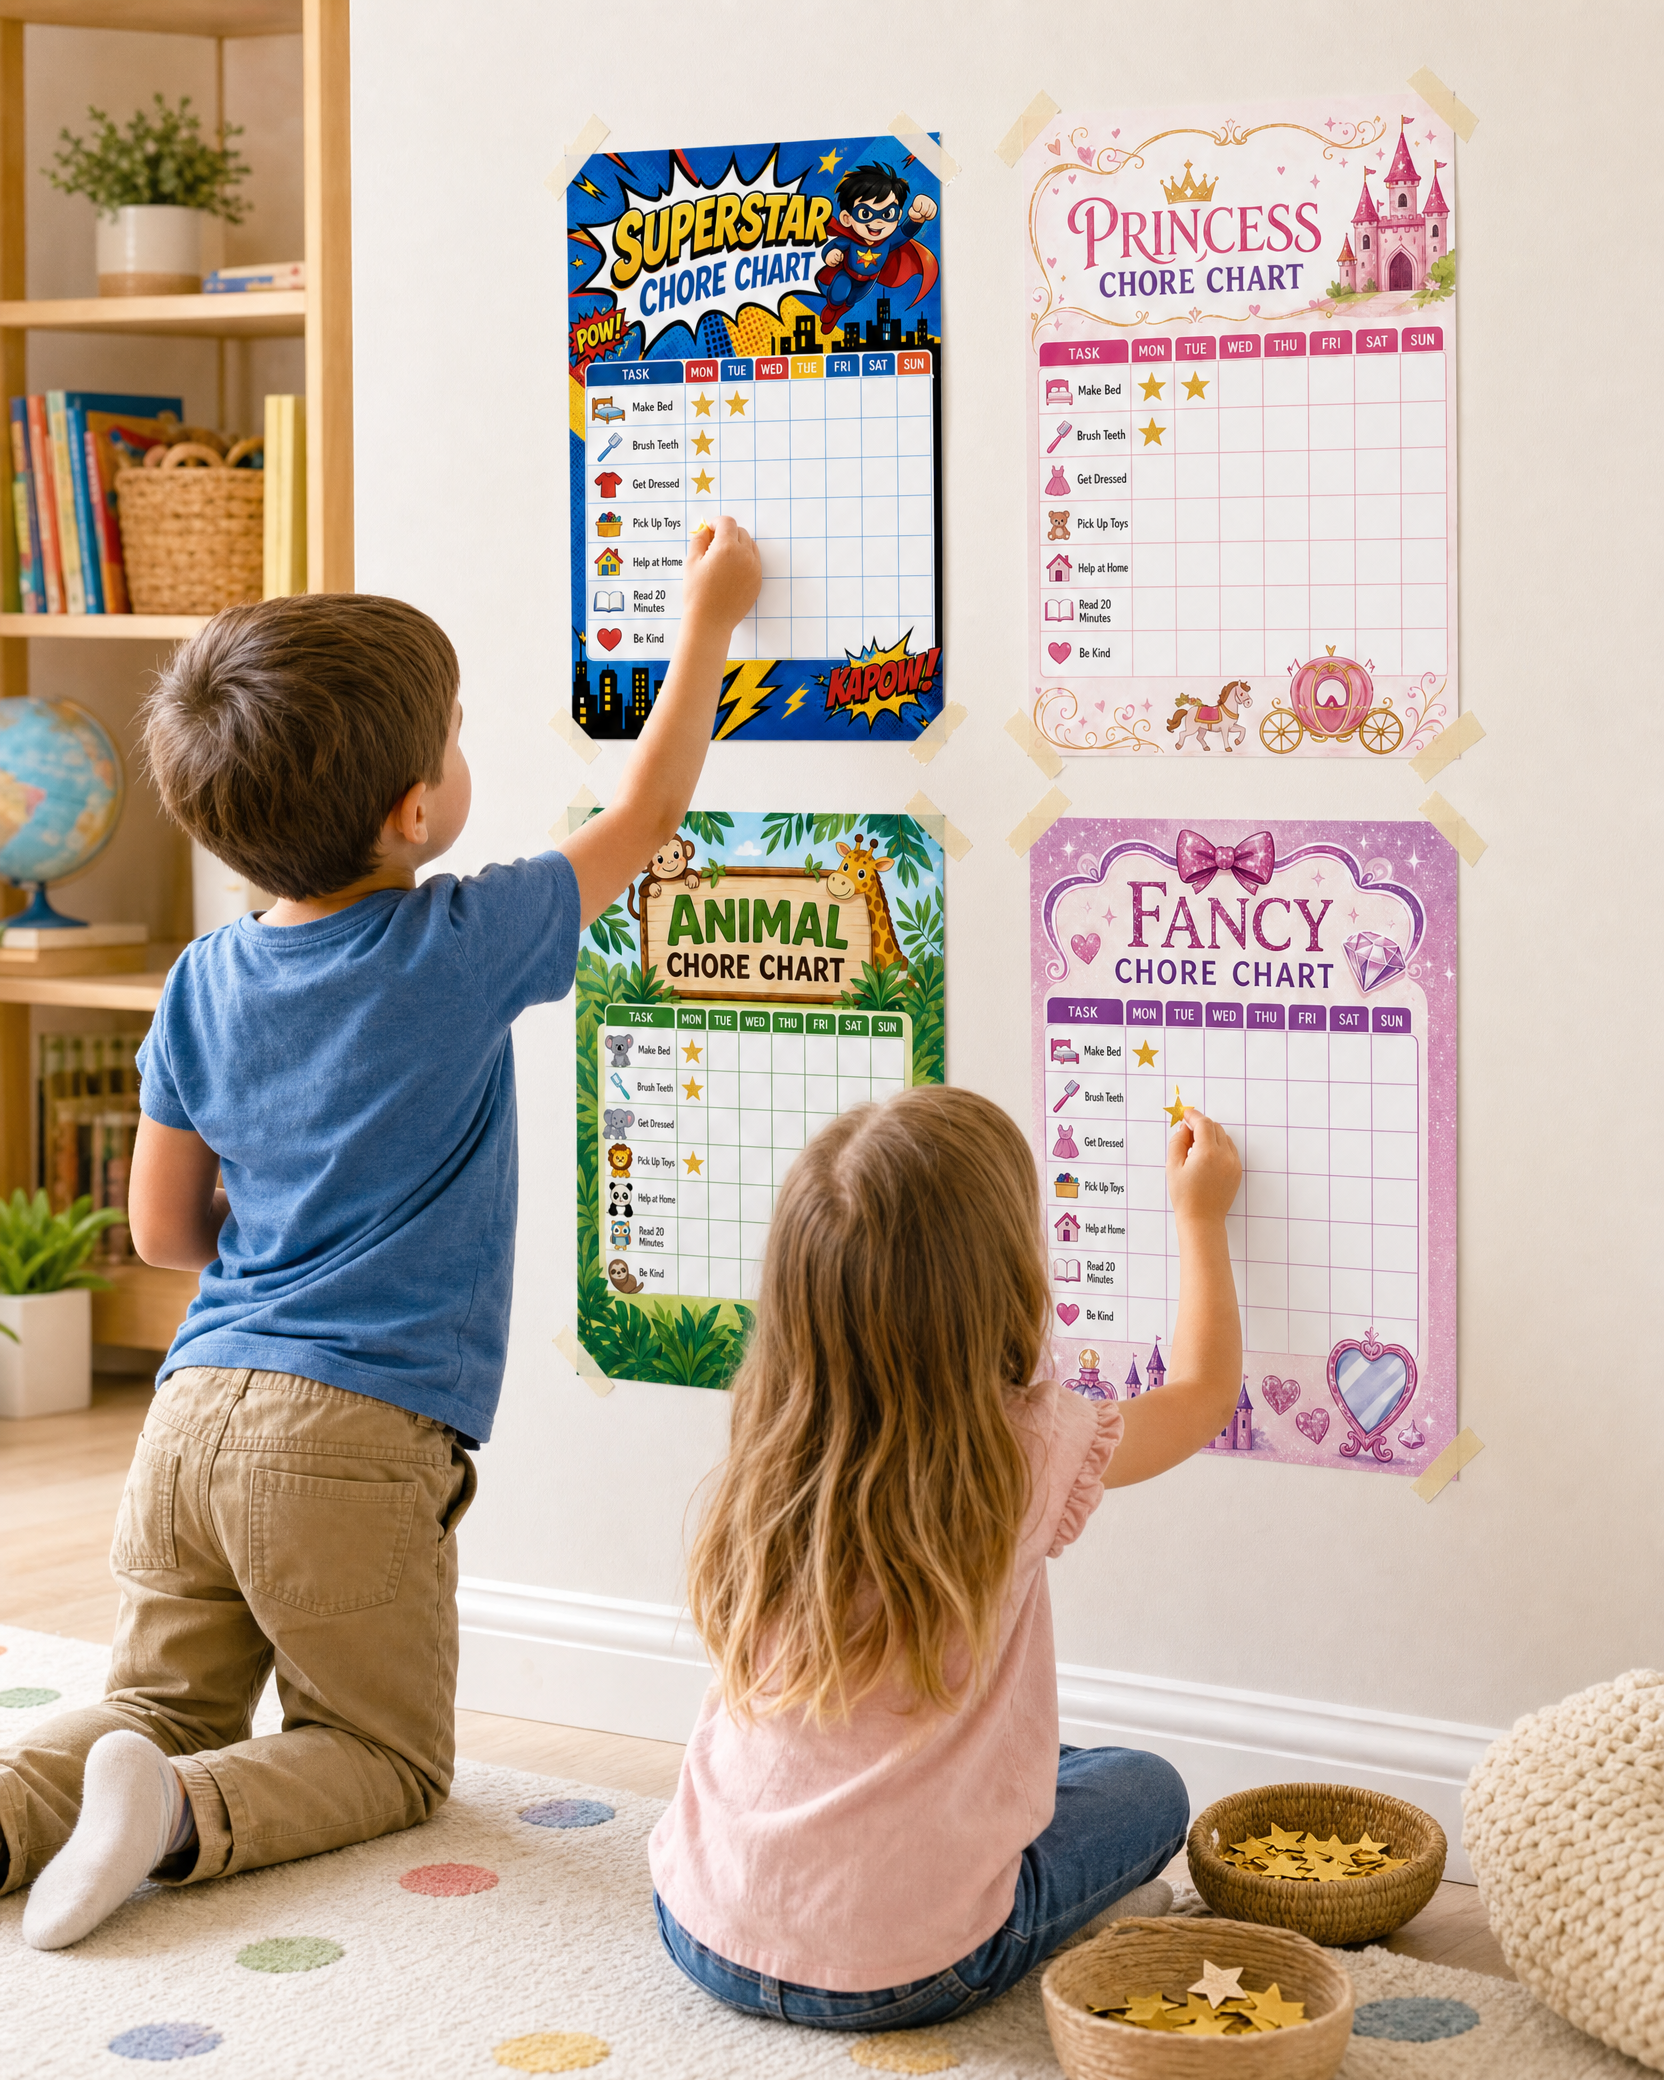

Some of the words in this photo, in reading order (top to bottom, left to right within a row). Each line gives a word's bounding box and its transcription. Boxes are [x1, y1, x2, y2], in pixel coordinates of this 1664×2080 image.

[1067, 196, 1322, 271] PRINCESS
[611, 192, 832, 289] SUPERSTAR
[639, 260, 726, 317] CHORE
[734, 251, 816, 296] CHART
[1099, 268, 1195, 298] CHORE
[1206, 263, 1304, 293] CHART
[574, 312, 623, 352] POW!
[1068, 347, 1100, 360] TASK
[1139, 345, 1165, 357] MON
[1184, 343, 1207, 355] TUE
[1227, 340, 1253, 353] WED
[1273, 339, 1297, 351] THU
[1322, 337, 1341, 349] FRI
[1366, 335, 1388, 348] SAT
[1410, 334, 1435, 346] SUN
[622, 369, 650, 380] TASK
[690, 367, 713, 377] MON
[728, 365, 746, 376] TUE
[761, 363, 783, 375] WED
[797, 362, 817, 374] TUE
[834, 360, 851, 372] FRI
[869, 359, 888, 370] SAT
[903, 358, 924, 370] SUN
[1078, 385, 1102, 396] Make
[1104, 384, 1121, 395] Bed
[632, 402, 654, 412] Make
[657, 400, 673, 411] Bed
[1077, 430, 1101, 441] Brush
[1103, 429, 1126, 440] Teeth
[632, 440, 655, 450] Brush
[657, 439, 679, 449] Teeth
[632, 479, 646, 489] Get
[648, 478, 679, 488] Dressed
[1077, 474, 1092, 484] Get
[1094, 473, 1127, 484] Dressed
[633, 518, 648, 528] Pick
[651, 518, 662, 530] Up
[664, 517, 681, 528] Toys
[1077, 518, 1094, 529] Pick
[1096, 518, 1108, 531] Up
[1110, 517, 1129, 529] Toys
[633, 558, 650, 569] Help
[652, 558, 660, 566] at
[661, 557, 682, 567] Home
[1078, 563, 1096, 576] Help
[1097, 564, 1105, 572] at
[1107, 563, 1129, 572] Home
[633, 591, 653, 600] Read
[655, 590, 666, 600] 20
[633, 603, 665, 612] Minutes
[1079, 599, 1099, 609] Read
[1100, 599, 1111, 609] 20
[1079, 613, 1111, 623] Minutes
[633, 634, 644, 643] Be
[646, 633, 664, 643] Kind
[1079, 648, 1090, 658] Be
[1092, 648, 1111, 658] Kind
[825, 647, 941, 708] KAPOW!
[667, 894, 848, 950] ANIMAL
[1127, 881, 1334, 953] FANCY
[666, 952, 750, 980] CHORE
[759, 955, 845, 983] CHART
[1114, 958, 1217, 986] CHORE
[1232, 961, 1334, 989] CHART
[629, 1012, 653, 1023] TASK
[681, 1014, 702, 1025] MON
[714, 1015, 732, 1026] TUE
[745, 1016, 765, 1028] WED
[778, 1017, 797, 1028] THU
[813, 1019, 828, 1030] FRI
[845, 1020, 862, 1031] SAT
[878, 1022, 897, 1032] SUN
[1068, 1006, 1098, 1019] TASK
[1132, 1008, 1157, 1020] MON
[1173, 1009, 1194, 1021] TUE
[1212, 1009, 1236, 1022] WED
[1255, 1010, 1277, 1023] THU
[1298, 1012, 1317, 1025] FRI
[1338, 1013, 1360, 1026] SAT
[1380, 1014, 1403, 1028] SUN
[638, 1045, 656, 1055] Make
[657, 1046, 670, 1055] Bed
[1084, 1045, 1105, 1056] Make
[1106, 1046, 1121, 1057] Bed
[637, 1082, 655, 1092] Brush
[656, 1083, 673, 1092] Teeth
[1084, 1091, 1104, 1102] Brush
[1105, 1092, 1124, 1103] Teeth
[638, 1118, 649, 1128] Get
[650, 1119, 674, 1129] Dressed
[1084, 1137, 1097, 1147] Get
[1097, 1138, 1124, 1148] Dressed
[637, 1156, 651, 1166] Pick
[651, 1157, 660, 1168] Up
[661, 1157, 675, 1168] Toys
[1084, 1181, 1098, 1192] Pick
[1099, 1182, 1108, 1194] Up
[1110, 1182, 1125, 1195] Toys
[638, 1193, 651, 1205] Help
[652, 1195, 658, 1203] at
[659, 1194, 676, 1204] Home
[639, 1226, 654, 1236] Read
[655, 1227, 664, 1236] 20
[1085, 1223, 1099, 1236] Help
[1100, 1224, 1107, 1234] at
[1108, 1224, 1125, 1235] Home
[639, 1237, 664, 1248] Minutes
[1087, 1261, 1103, 1271] Read
[1106, 1262, 1115, 1272] 20
[639, 1268, 648, 1277] Be
[649, 1268, 664, 1278] Kind
[1087, 1274, 1114, 1284] Minutes
[1086, 1310, 1096, 1320] Be
[1097, 1310, 1114, 1321] Kind
